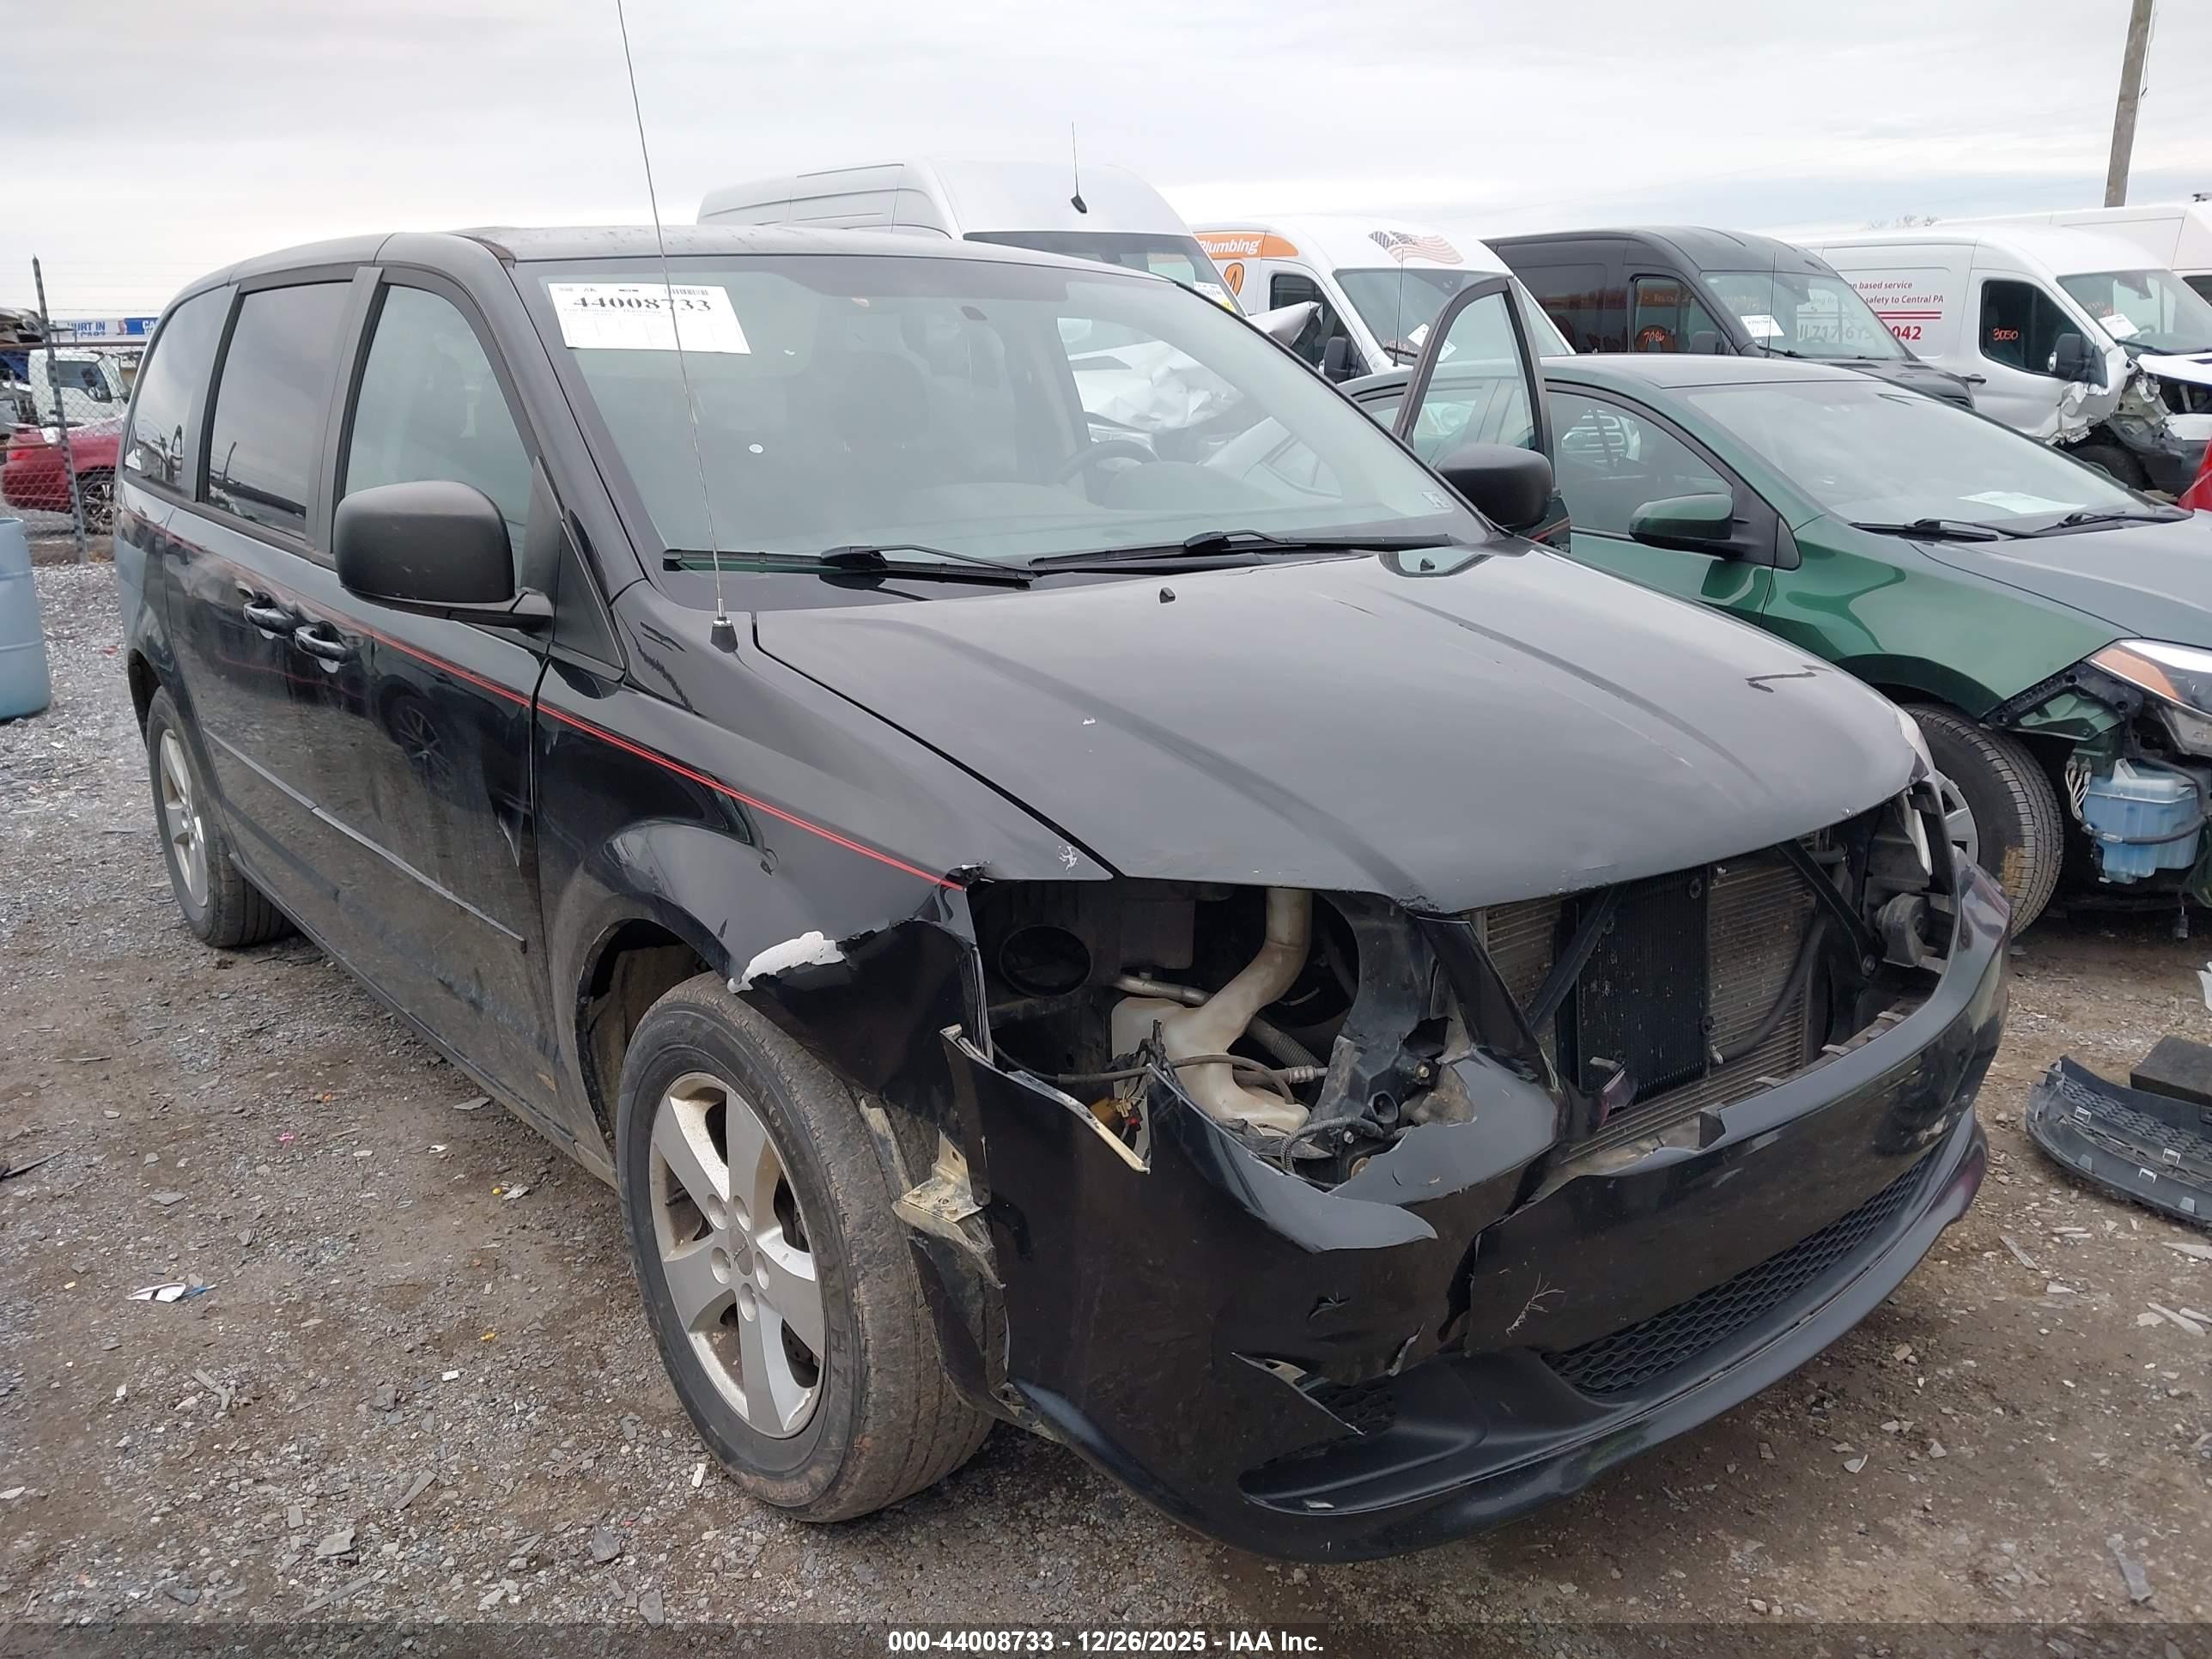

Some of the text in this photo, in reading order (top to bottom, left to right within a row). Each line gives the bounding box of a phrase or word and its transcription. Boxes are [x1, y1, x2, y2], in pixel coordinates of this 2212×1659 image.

[1199, 239, 1261, 255] Plumbing
[1884, 281, 1912, 289] service
[574, 297, 711, 311] 44008733
[1866, 295, 1889, 306] safety
[1901, 295, 1931, 303] Central
[1933, 295, 1945, 303] PA
[95, 321, 105, 331] IN
